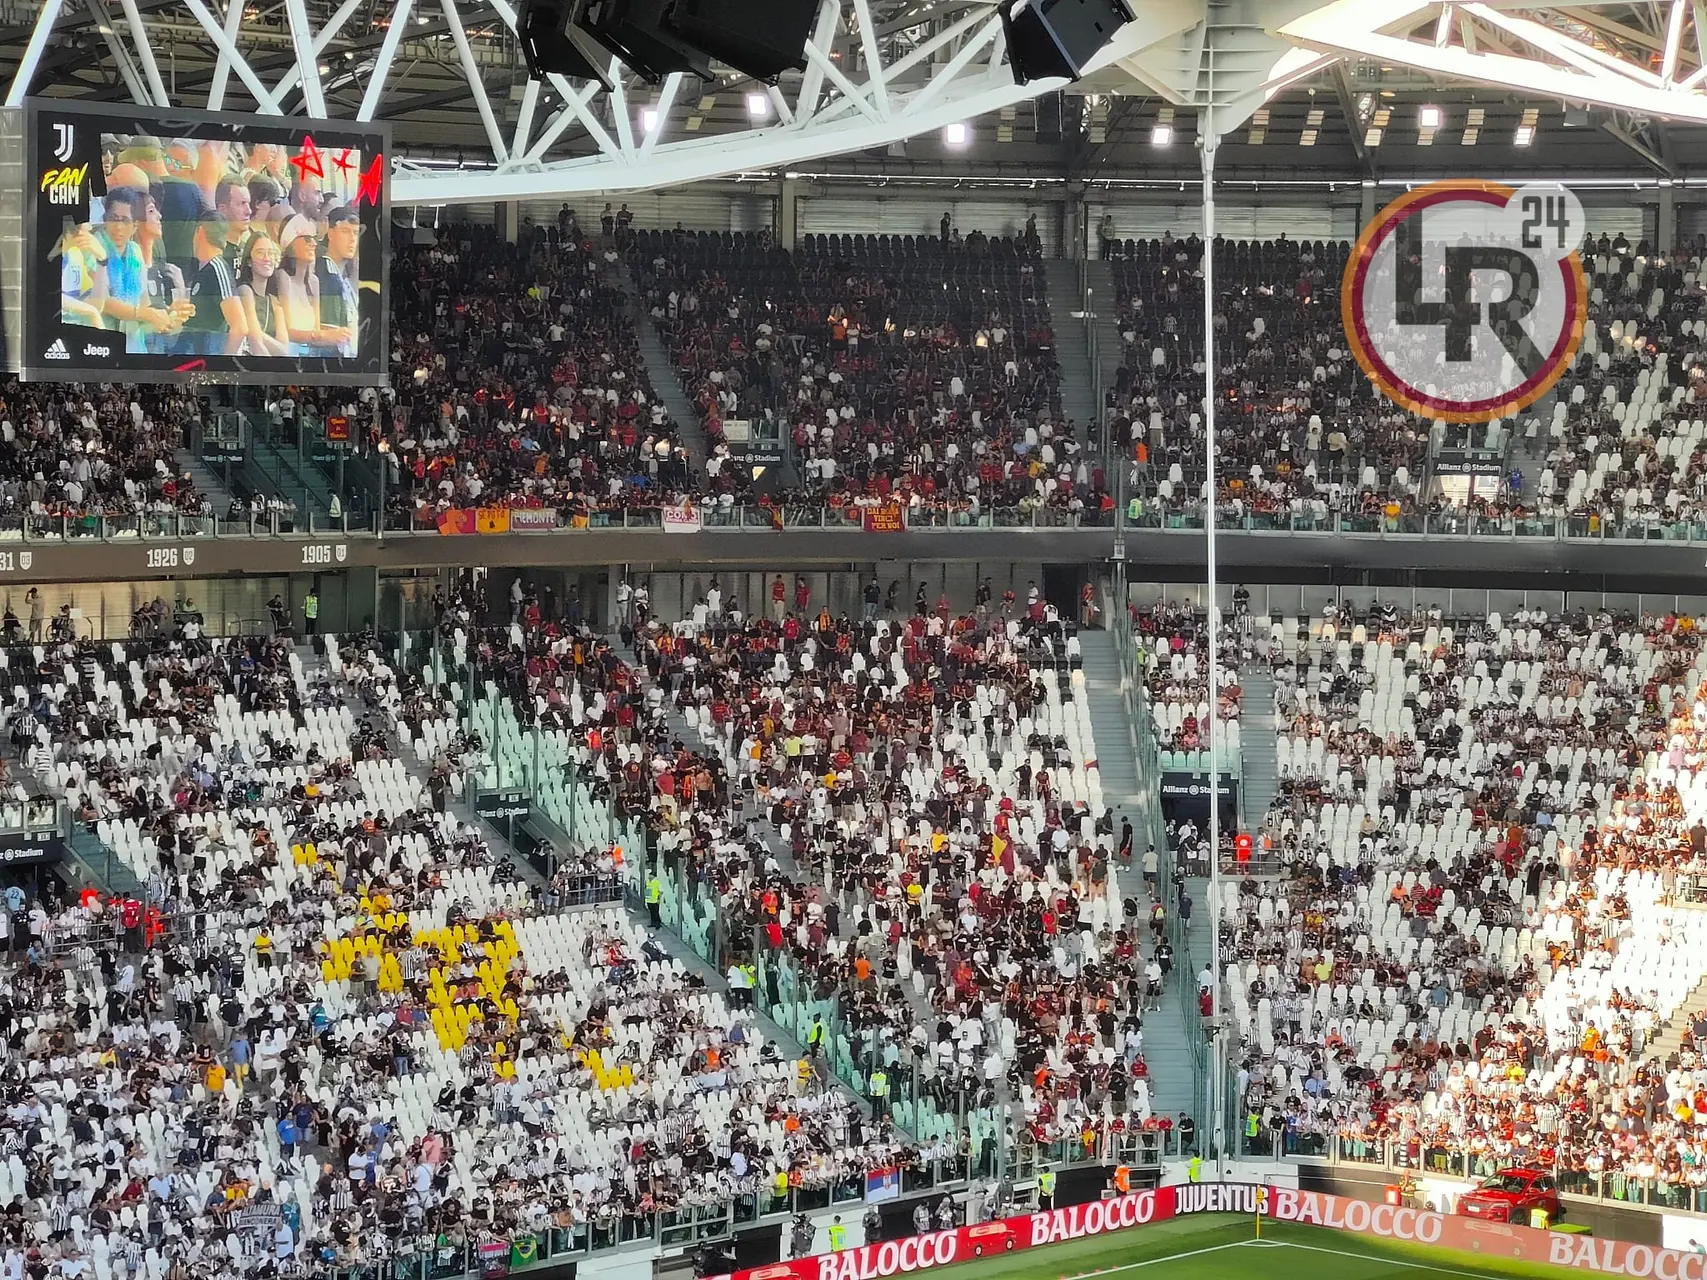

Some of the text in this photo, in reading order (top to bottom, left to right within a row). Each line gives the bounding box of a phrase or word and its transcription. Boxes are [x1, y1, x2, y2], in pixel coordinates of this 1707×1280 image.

[41, 162, 89, 192] FAN
[50, 184, 79, 205] CAM
[44, 352, 70, 360] adidas
[83, 343, 110, 358] Jeep
[1437, 463, 1501, 471] Allianz Stadium
[147, 548, 178, 567] 1926
[302, 545, 331, 564] 1905
[1162, 785, 1230, 794] Allianz Staum
[14, 848, 44, 858] Stadium
[1175, 1184, 1269, 1215] JUVENTUS
[1030, 1190, 1156, 1246] BALOCCO
[1275, 1188, 1444, 1243] BALOCCO
[817, 1231, 958, 1280] BALOCCO
[1549, 1232, 1707, 1280] BALOCC
